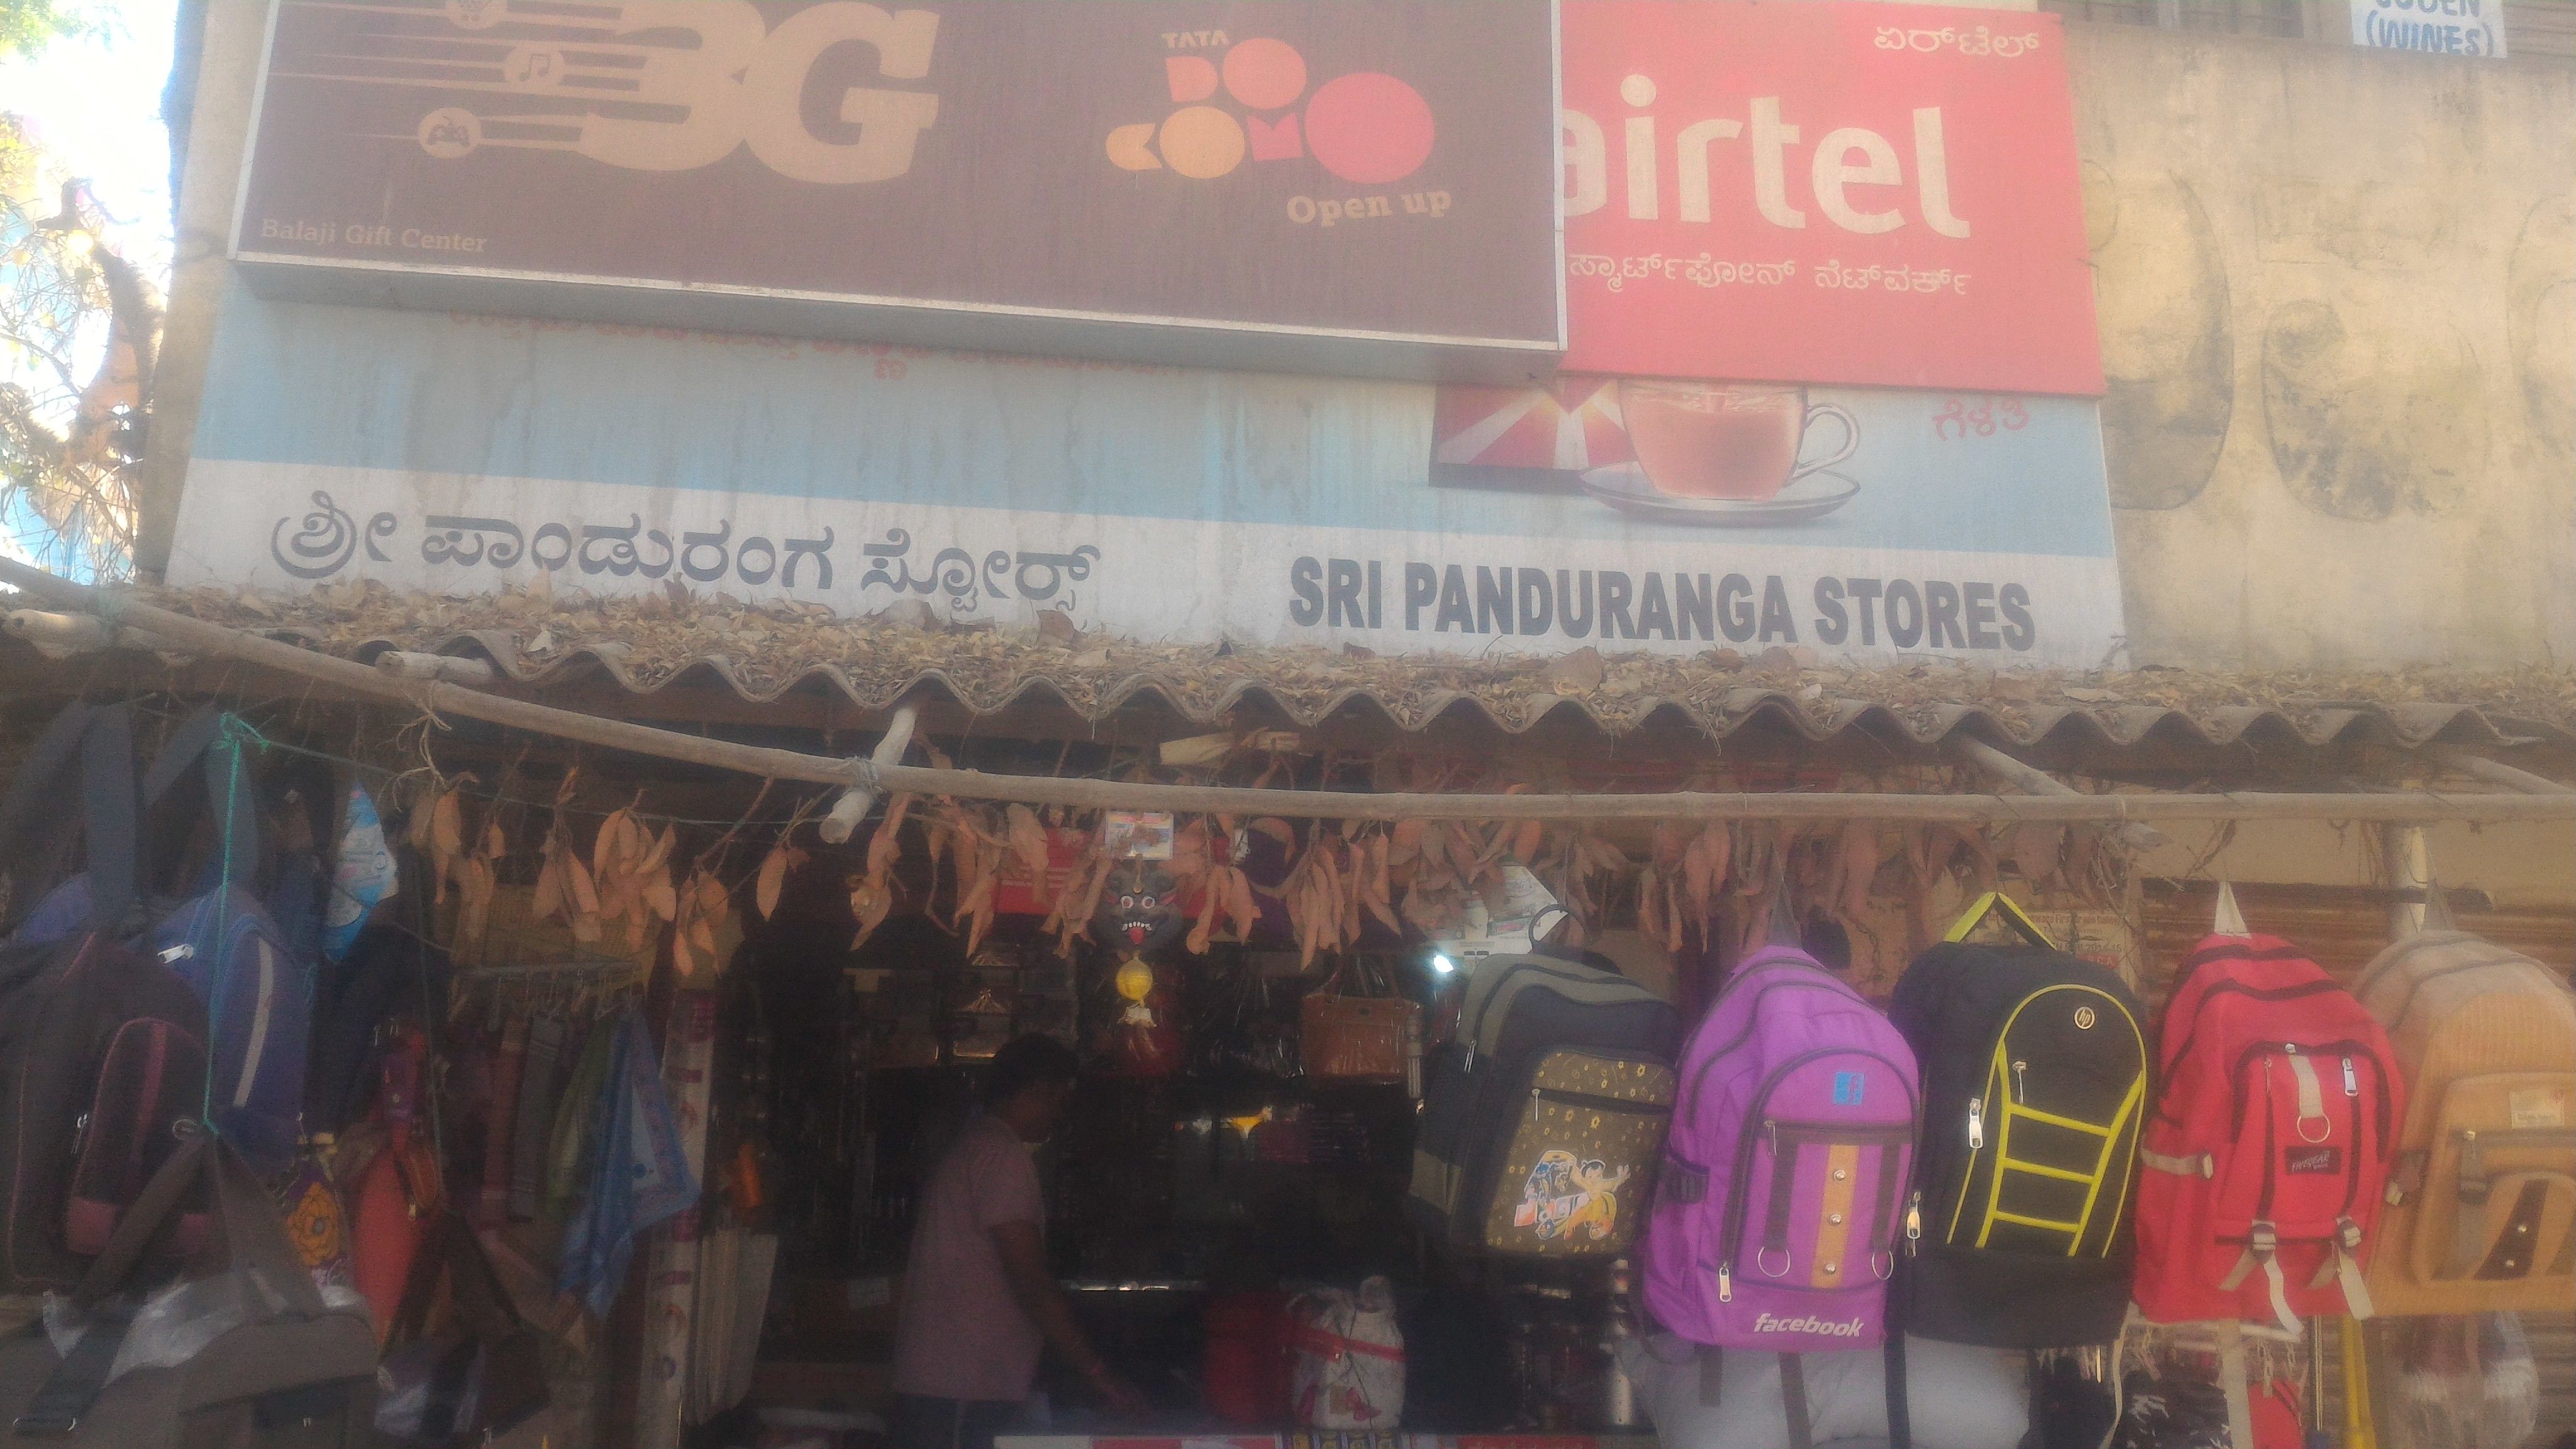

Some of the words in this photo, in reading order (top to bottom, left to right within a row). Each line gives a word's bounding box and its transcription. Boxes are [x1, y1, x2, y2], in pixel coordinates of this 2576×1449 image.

[1162, 30, 1228, 49] TATA
[2366, 9, 2494, 57] (WINES)
[569, 0, 941, 184] 3G
[1287, 195, 1392, 227] Open
[1400, 190, 1452, 219] up
[261, 219, 336, 245] Balaji
[346, 224, 392, 246] Gift
[402, 228, 487, 252] Center
[271, 490, 397, 579] ಶ್ರೀ
[421, 512, 835, 590] ಪಾಂಡುರಂಗ
[1289, 556, 1382, 629] SRI
[1404, 561, 1798, 643] PANDURANGA
[1814, 575, 2036, 652] STORES
[1754, 1313, 1864, 1337] facebook
